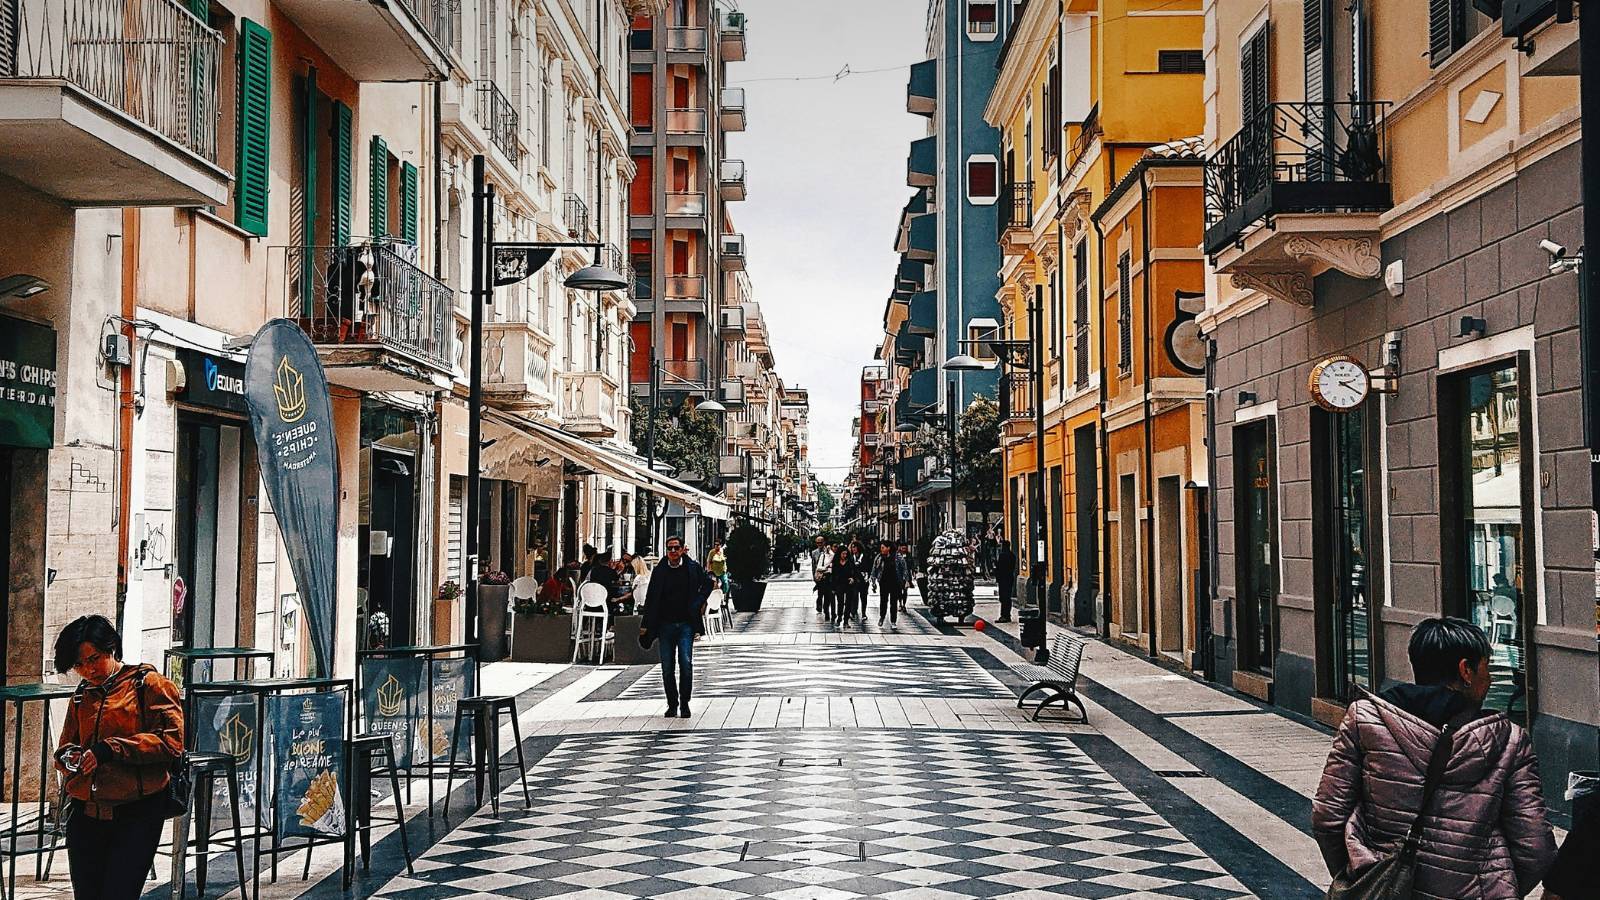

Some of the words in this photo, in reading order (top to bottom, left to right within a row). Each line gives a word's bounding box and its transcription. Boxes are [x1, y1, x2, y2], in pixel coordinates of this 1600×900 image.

[20, 364, 57, 388] CHIPS
[371, 721, 408, 732] QUEEN'S
[291, 739, 326, 756] BUONE
[300, 755, 333, 770] REAME
